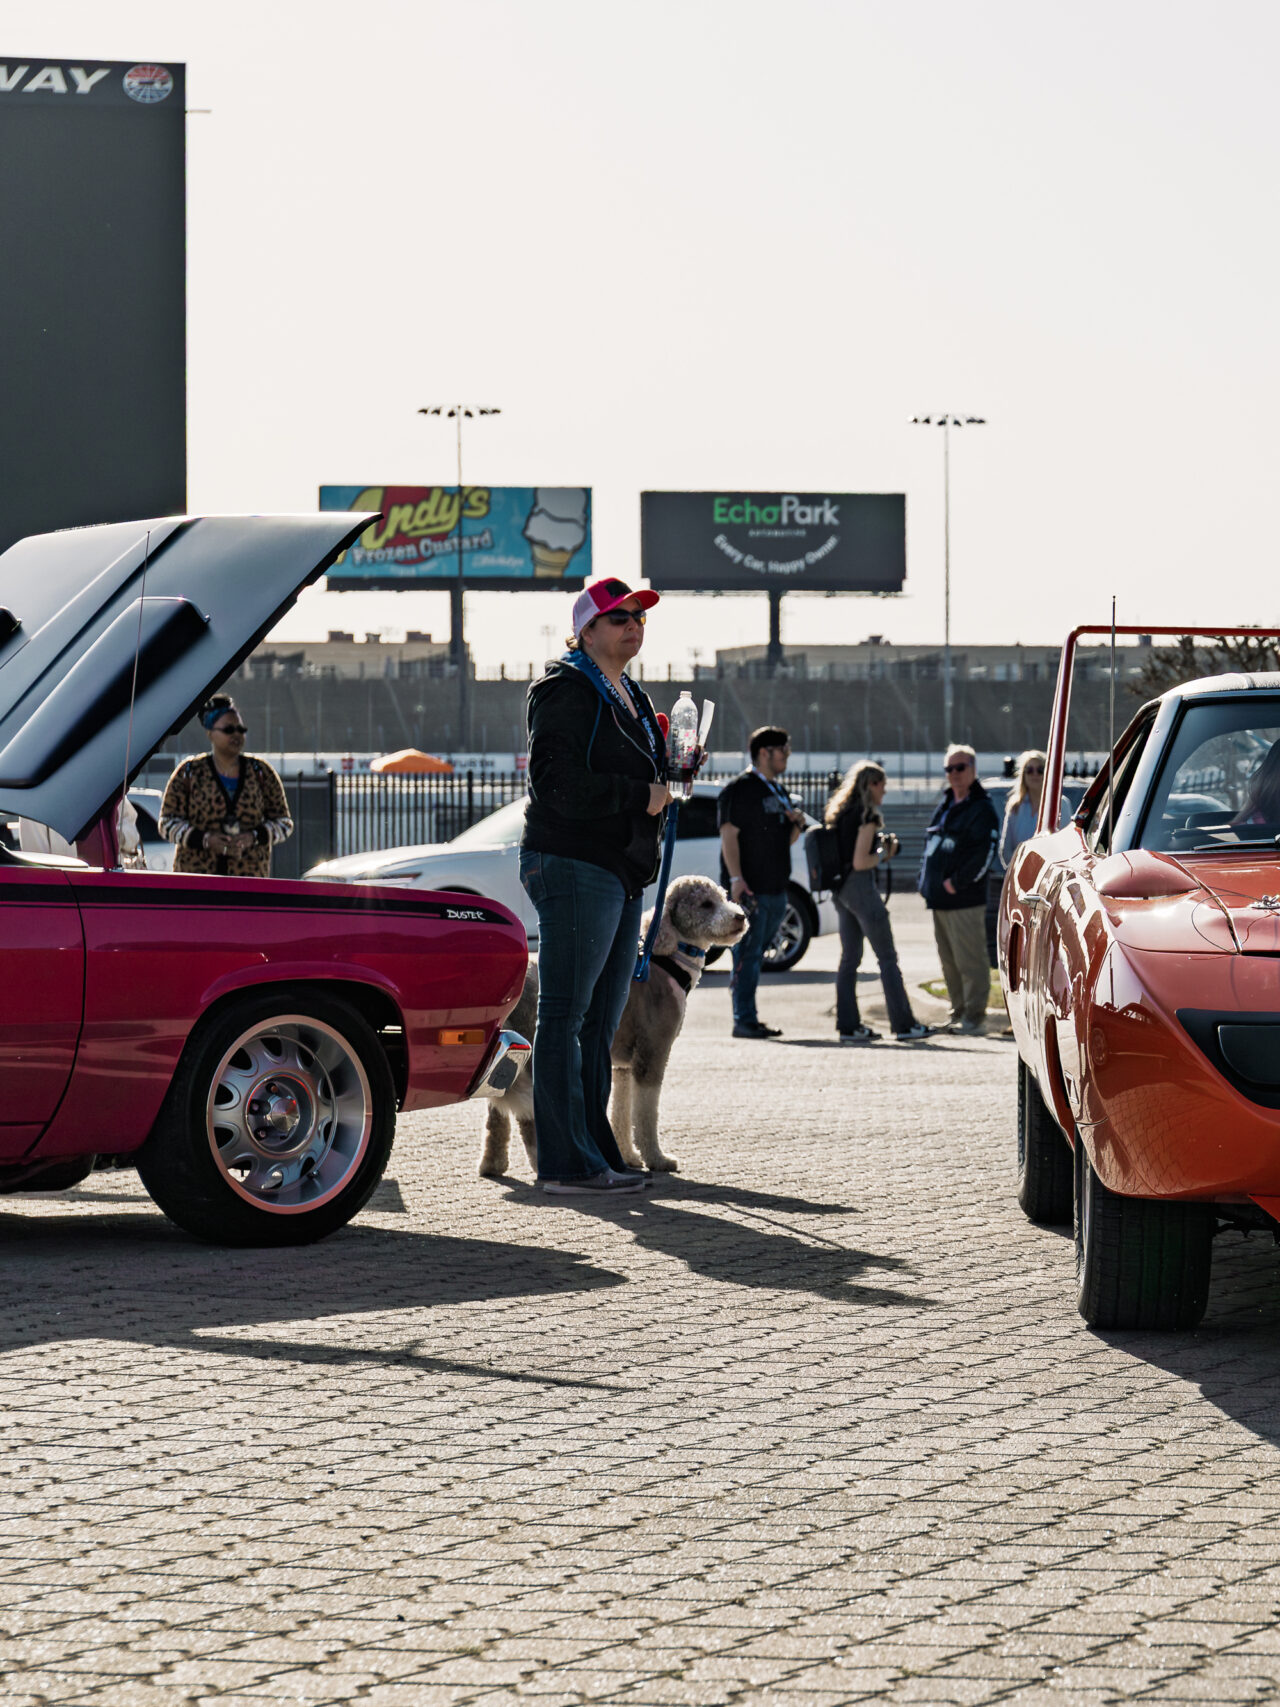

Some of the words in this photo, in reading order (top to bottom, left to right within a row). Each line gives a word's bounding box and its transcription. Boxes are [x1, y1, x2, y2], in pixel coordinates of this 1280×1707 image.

[339, 487, 491, 552] Andy's
[713, 495, 840, 525] EchoPark
[352, 543, 418, 566] Frozen
[419, 529, 493, 556] Custard
[714, 534, 744, 564] Every
[768, 560, 805, 575] Happy
[446, 908, 486, 921] DUSTER
